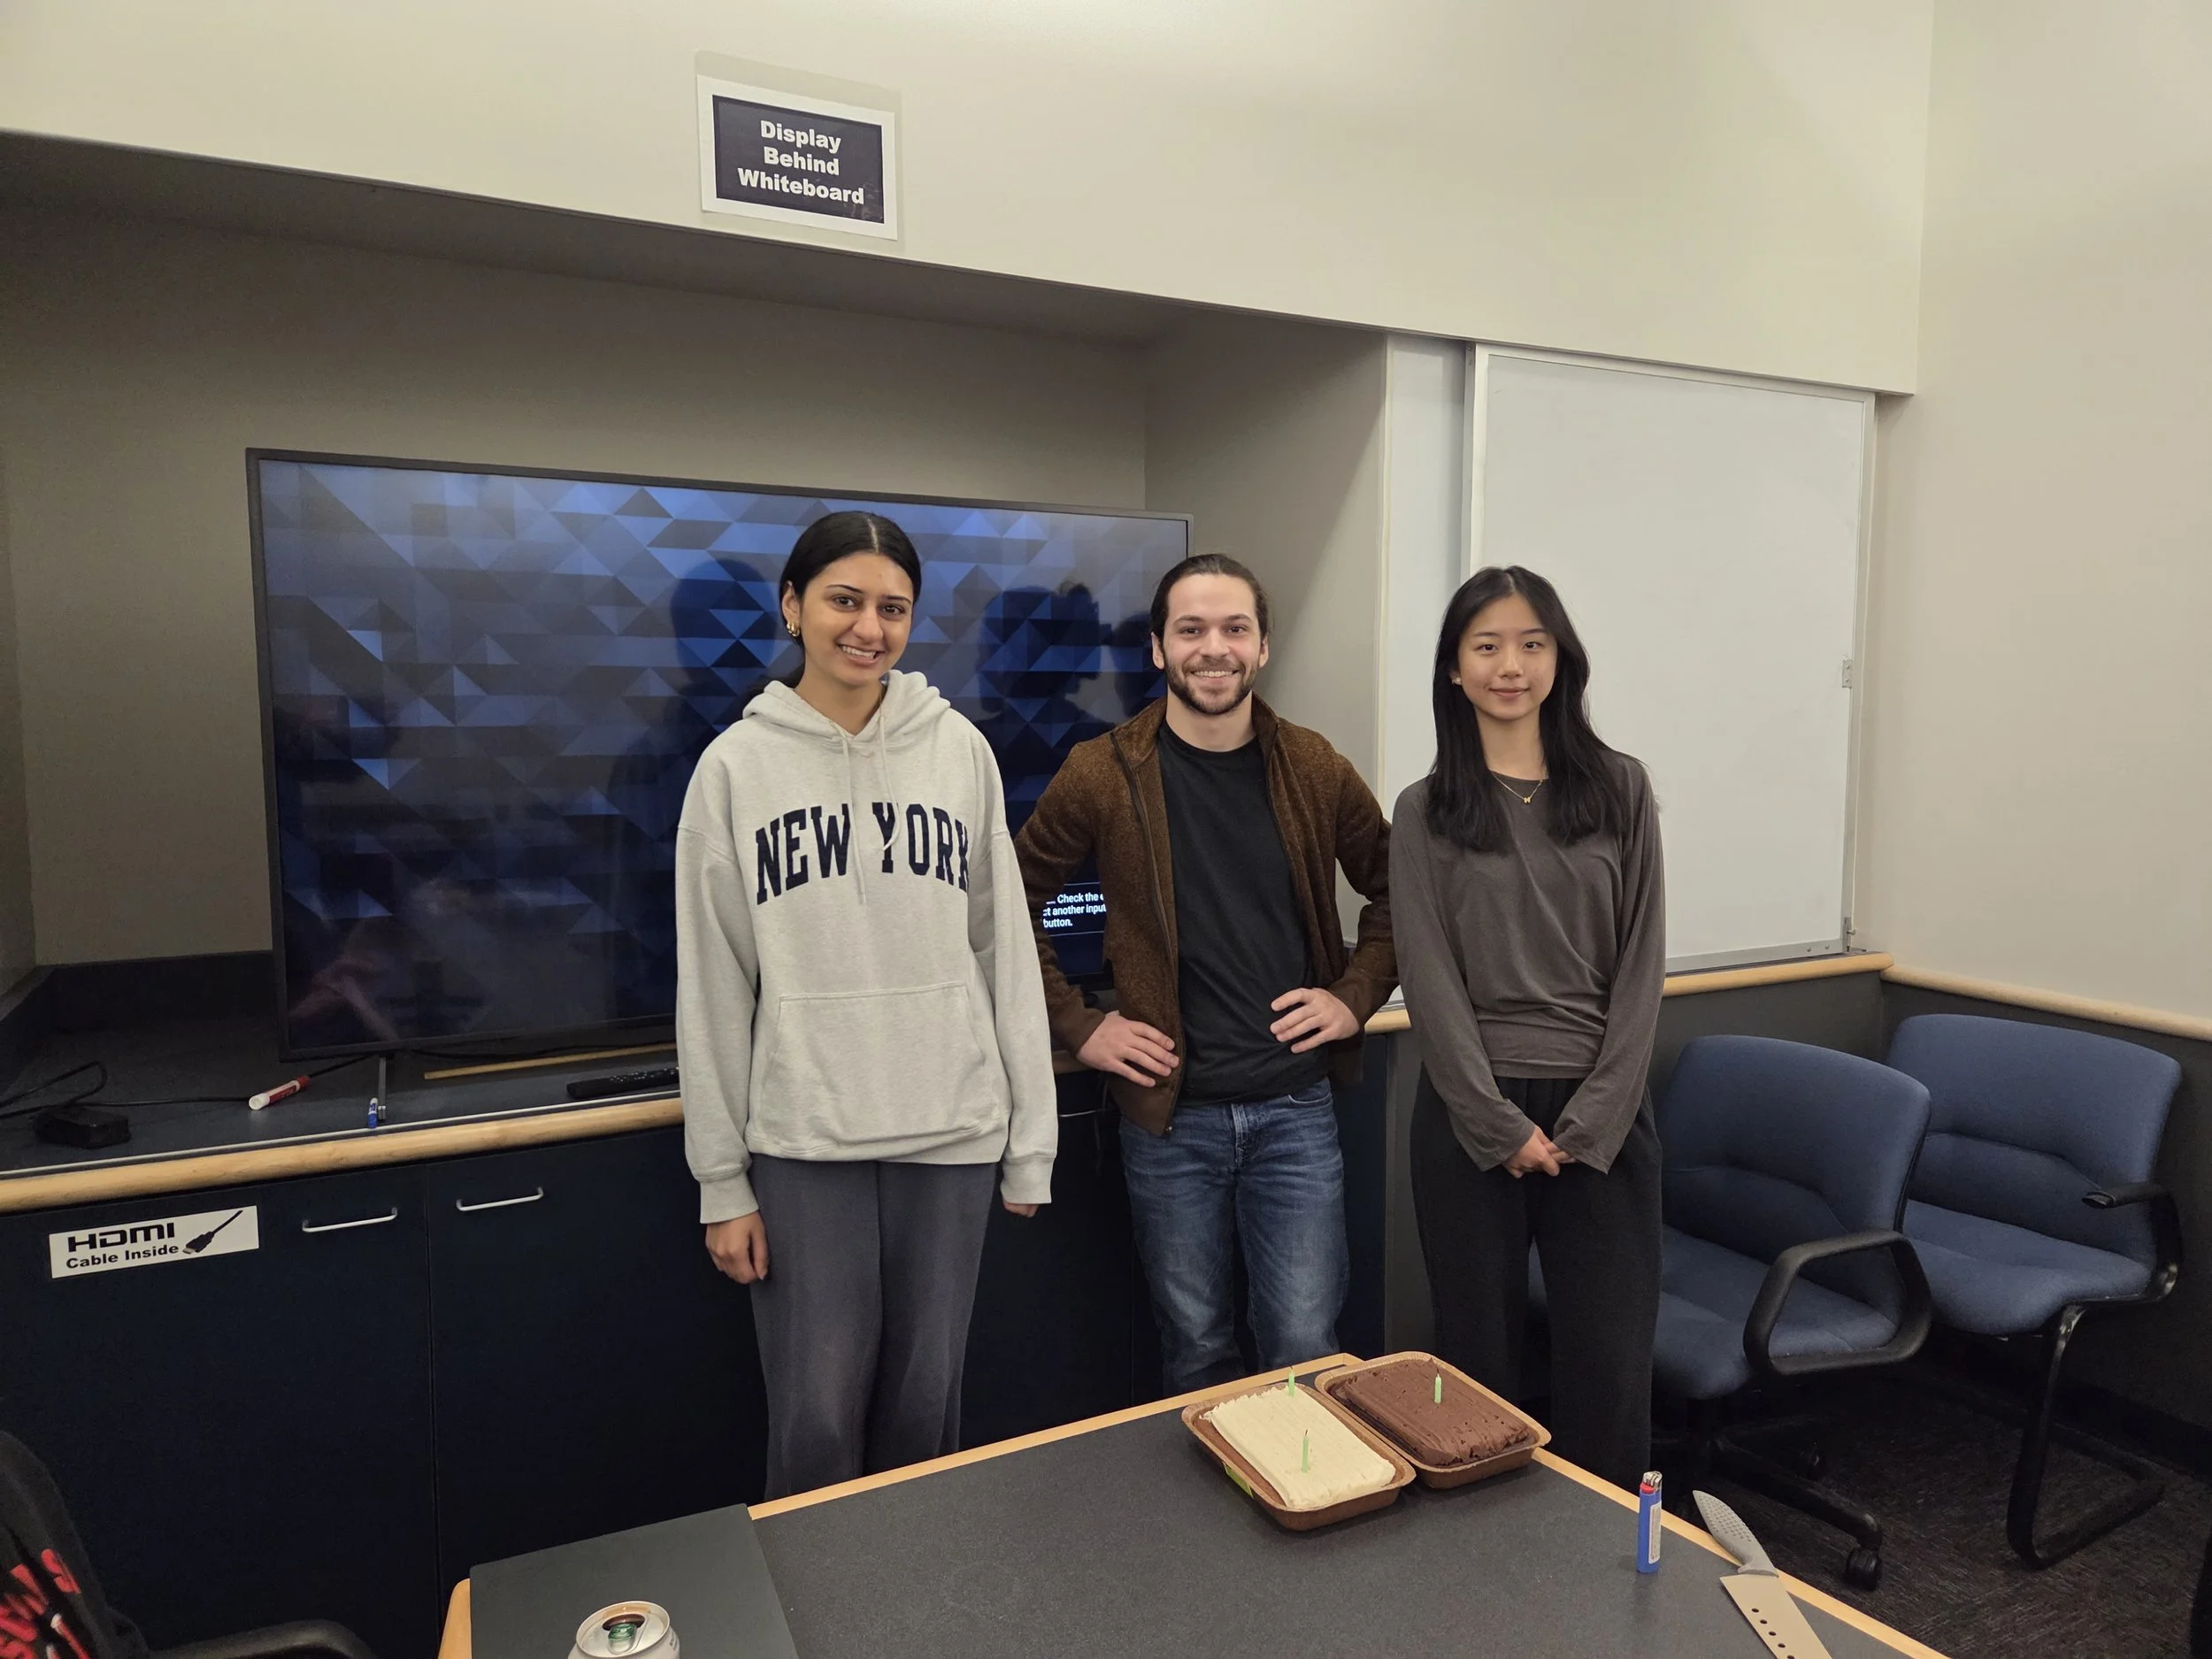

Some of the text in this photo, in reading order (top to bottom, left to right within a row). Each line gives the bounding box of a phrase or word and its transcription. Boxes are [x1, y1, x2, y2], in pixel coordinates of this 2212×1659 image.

[760, 119, 841, 154] Display
[764, 146, 840, 176] Behind
[737, 167, 864, 204] Whiteboard
[755, 802, 970, 906] NEW YORK
[1053, 905, 1085, 916] another
[1086, 903, 1106, 915] input
[1057, 893, 1084, 903] Check
[1085, 892, 1099, 901] the
[1043, 918, 1072, 928] button.
[67, 1222, 175, 1253] HDMI
[65, 1243, 180, 1269] Cable Inside
